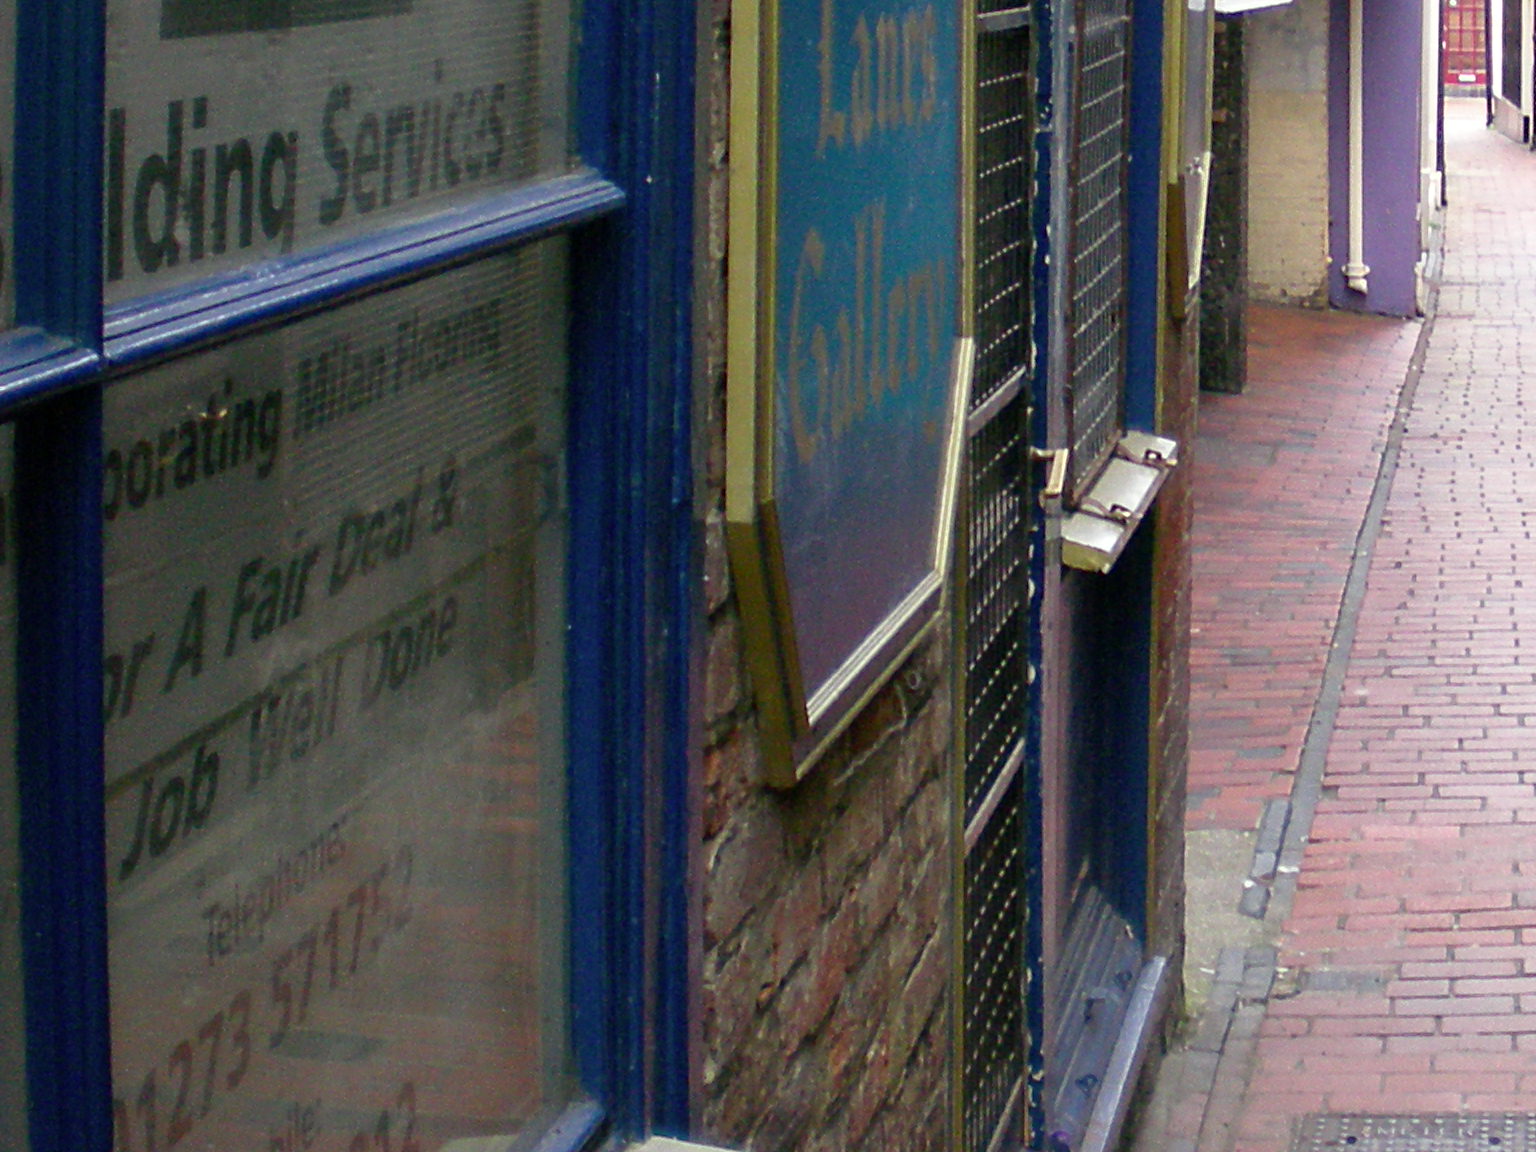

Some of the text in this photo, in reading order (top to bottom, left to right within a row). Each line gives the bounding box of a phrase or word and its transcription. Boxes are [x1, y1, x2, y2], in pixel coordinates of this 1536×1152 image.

[319, 70, 506, 226] Services
[788, 198, 945, 465] Gallery
[164, 585, 207, 695] A
[224, 530, 320, 657] Fair
[329, 465, 423, 597] Deal
[118, 595, 458, 881] Job Well Done
